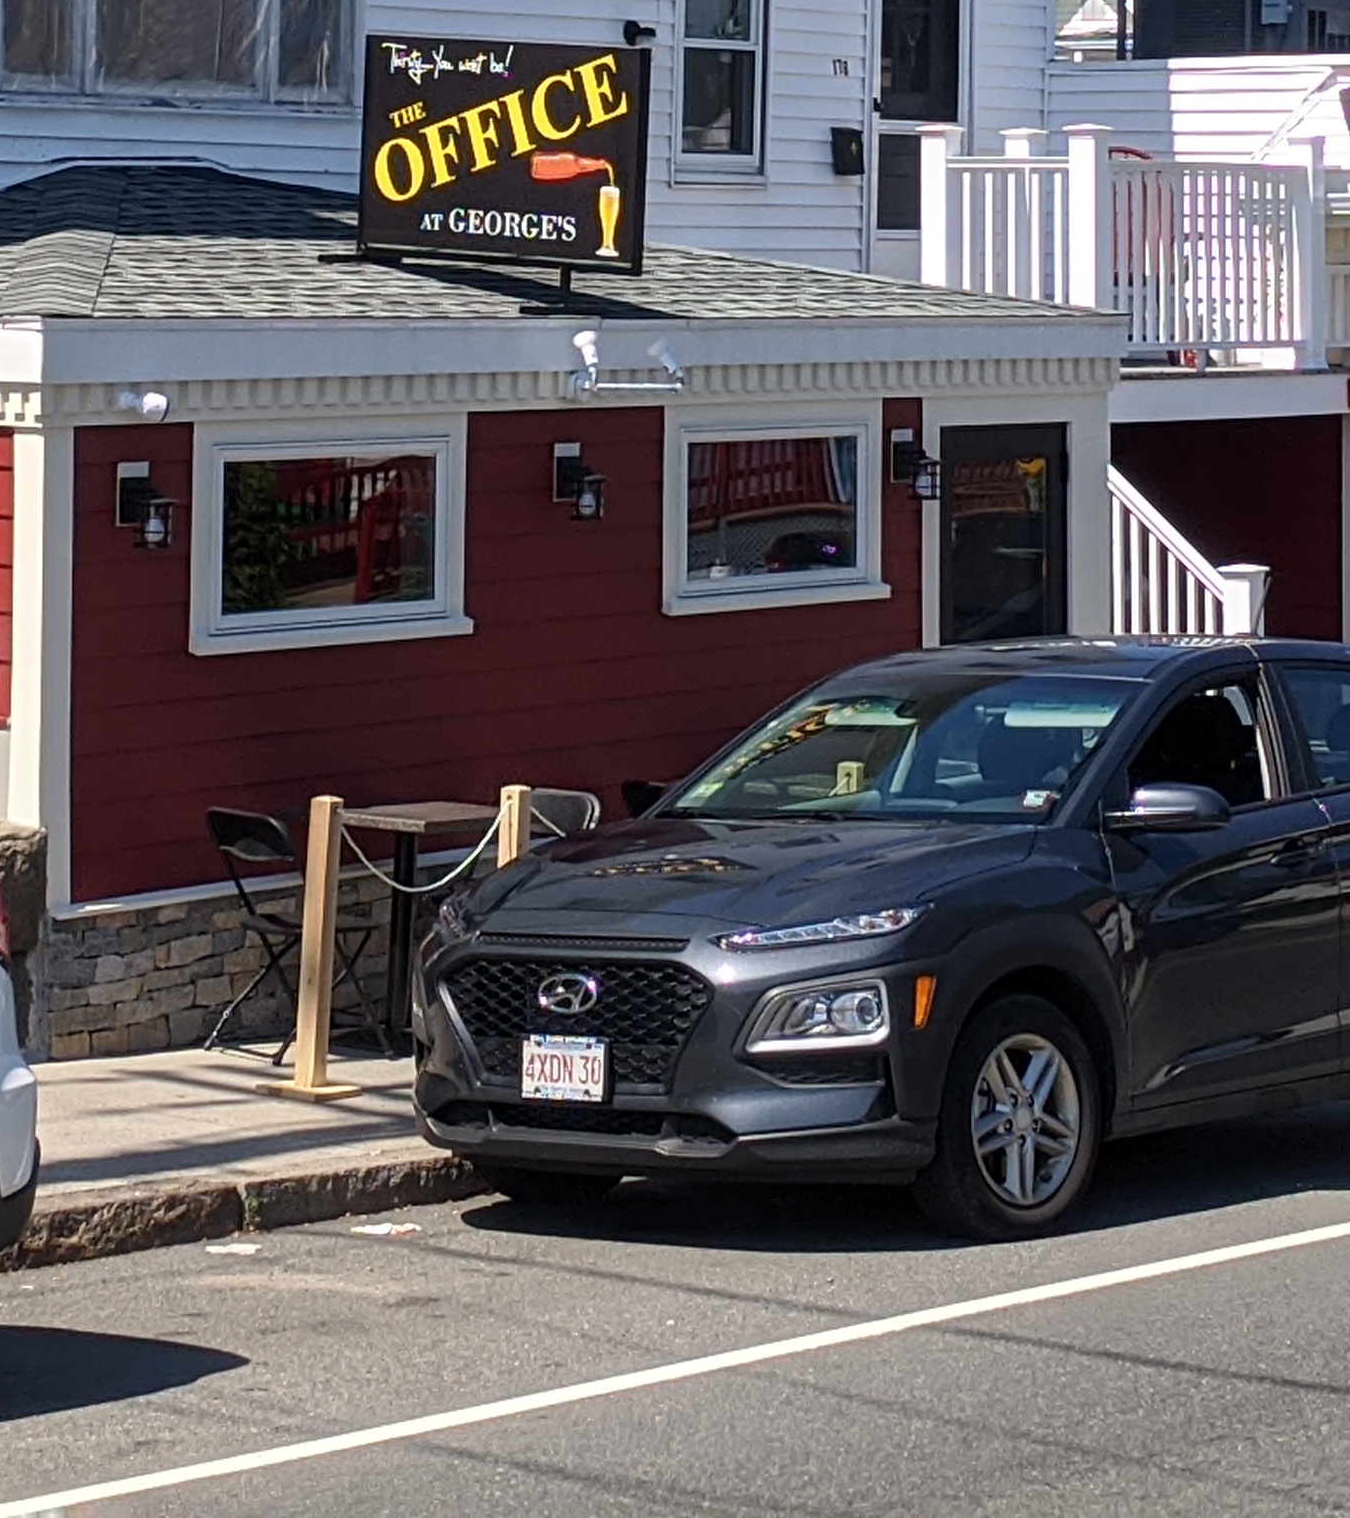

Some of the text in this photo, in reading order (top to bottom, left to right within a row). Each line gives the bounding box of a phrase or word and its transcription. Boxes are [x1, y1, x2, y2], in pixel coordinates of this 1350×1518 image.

[374, 53, 629, 202] OFFICE
[389, 101, 426, 129] THE
[419, 207, 577, 241] AT GEORGE'S
[525, 1053, 602, 1085] 4XDN 30
